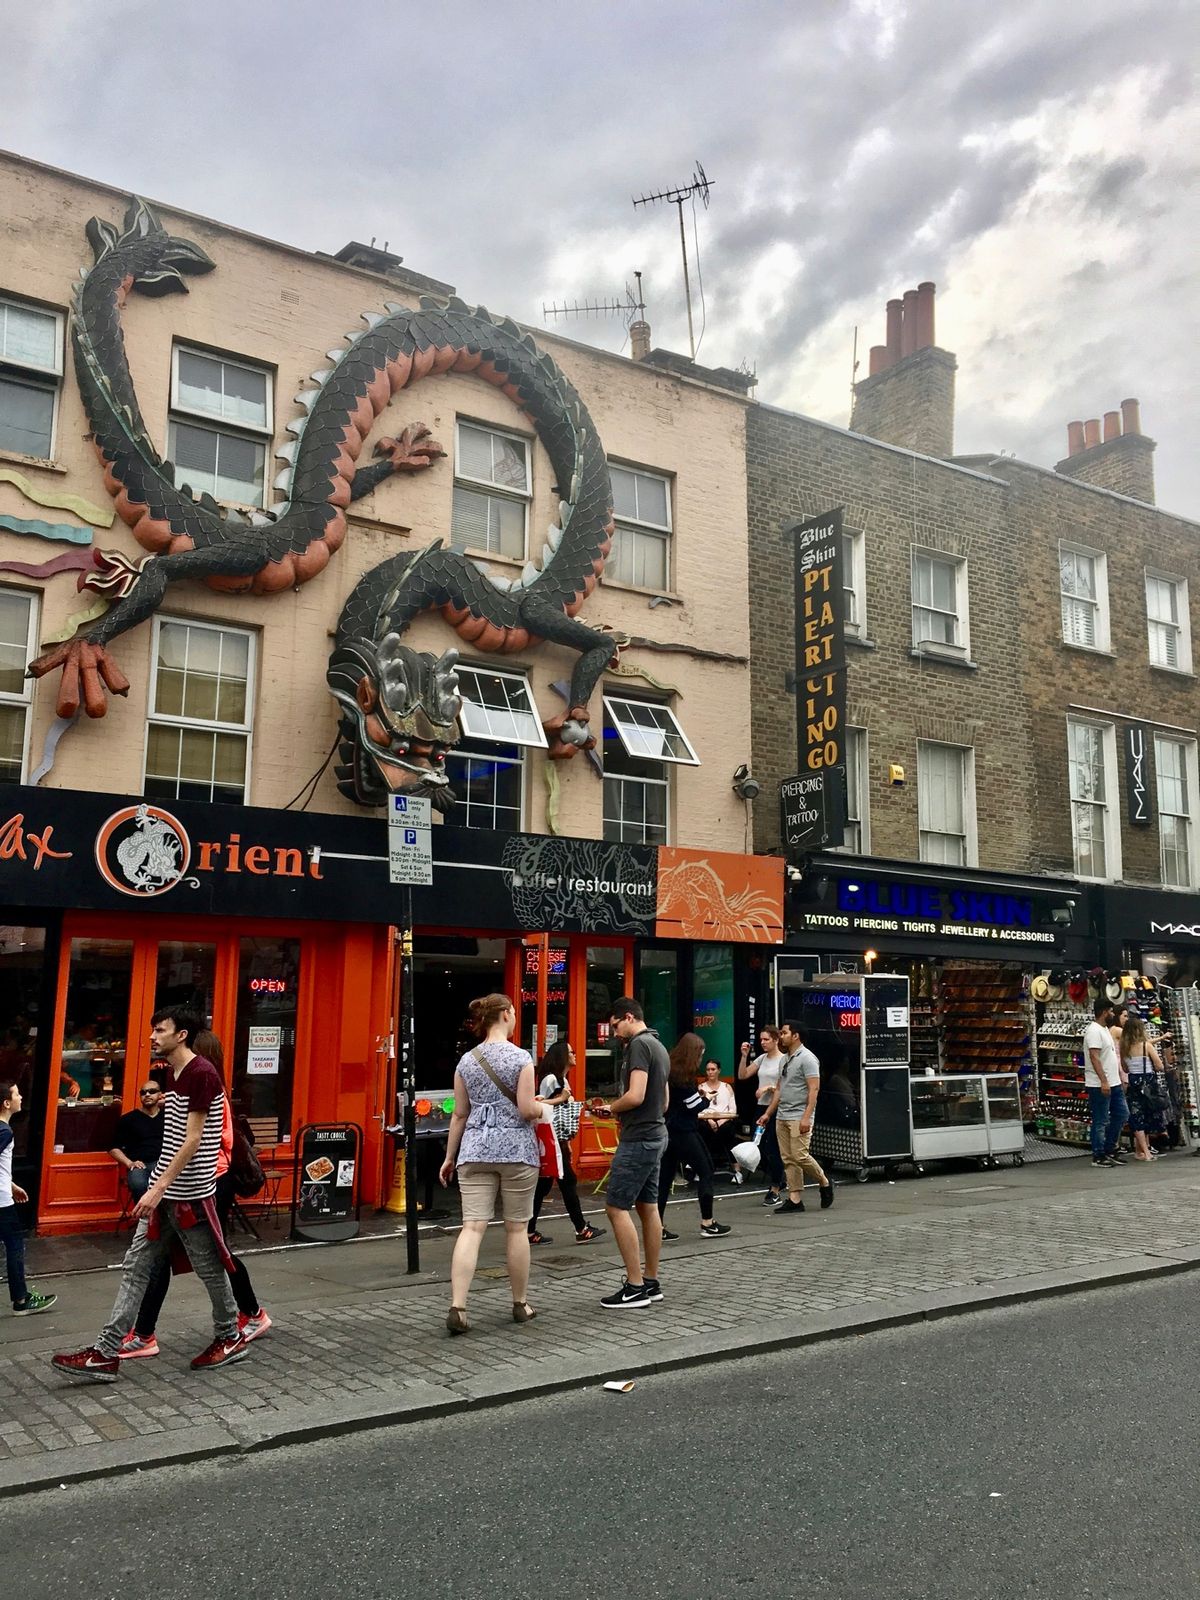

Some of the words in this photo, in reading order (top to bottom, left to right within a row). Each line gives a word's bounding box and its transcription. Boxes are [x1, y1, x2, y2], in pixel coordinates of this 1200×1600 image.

[800, 524, 834, 550] Blue
[800, 545, 836, 574] Skin
[820, 565, 839, 767] TATTOO
[781, 776, 823, 799] PIERCING
[407, 799, 425, 807] Loading
[798, 796, 808, 810] &
[786, 808, 818, 827] TATTOO
[569, 876, 653, 896] restaurant
[837, 878, 942, 919] BLUE
[951, 889, 1032, 927] SKIN
[804, 914, 849, 927] TATTOOS
[853, 917, 898, 931] PIERCING
[903, 921, 936, 934] TIGHTS
[940, 924, 990, 938] JEWELLERY
[991, 928, 998, 939] &
[1000, 929, 1055, 943] ACCESSORIES
[526, 951, 567, 962] CHESE
[526, 961, 553, 972] FOD
[250, 979, 286, 992] OPEN
